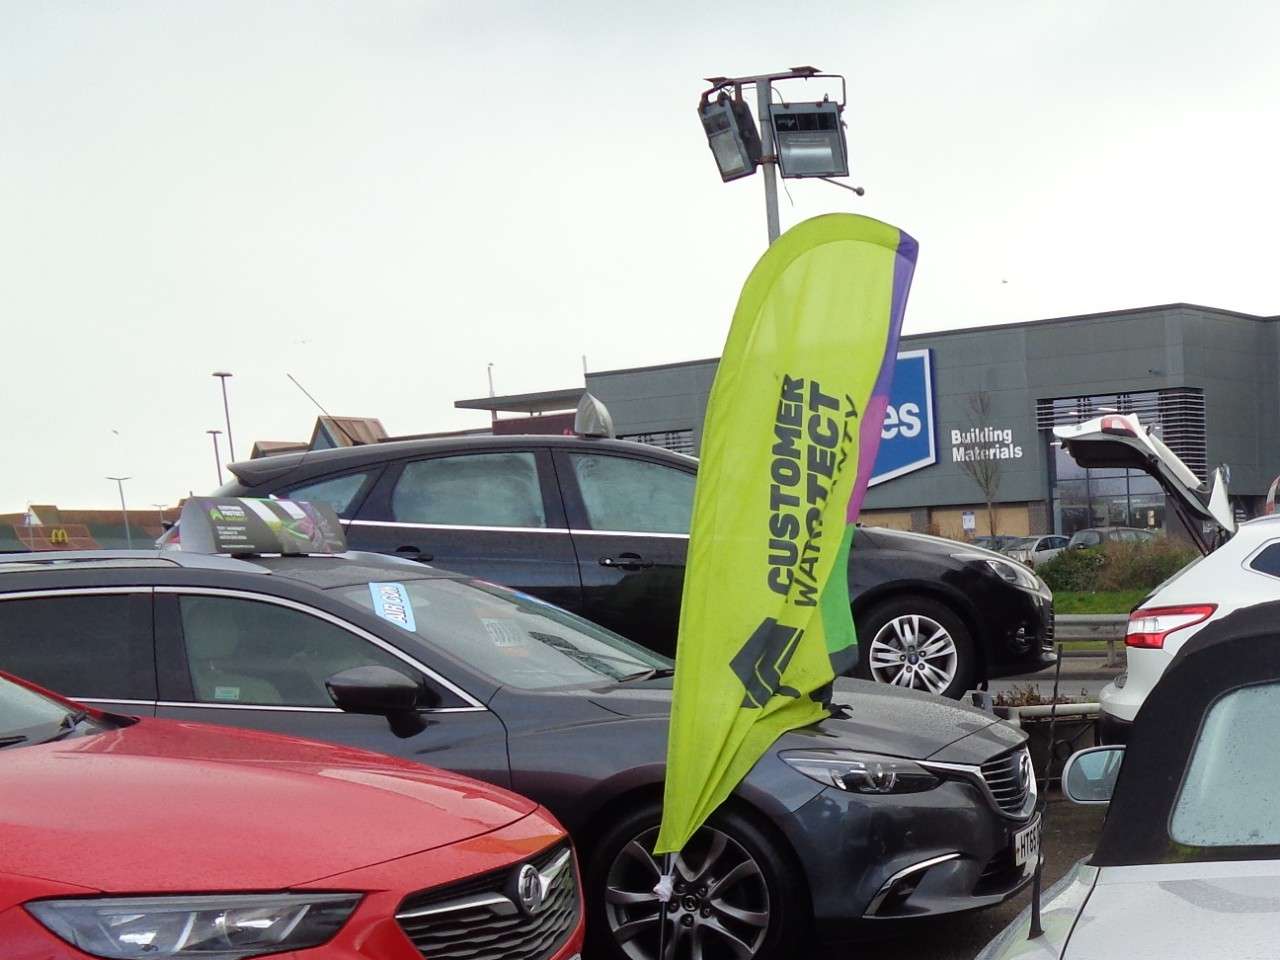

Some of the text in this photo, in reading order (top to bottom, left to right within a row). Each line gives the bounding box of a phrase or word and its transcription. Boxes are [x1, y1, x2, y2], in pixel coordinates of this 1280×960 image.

[951, 427, 1012, 445] Building
[952, 445, 1023, 463] Materials
[768, 374, 805, 600] CUSTOMER
